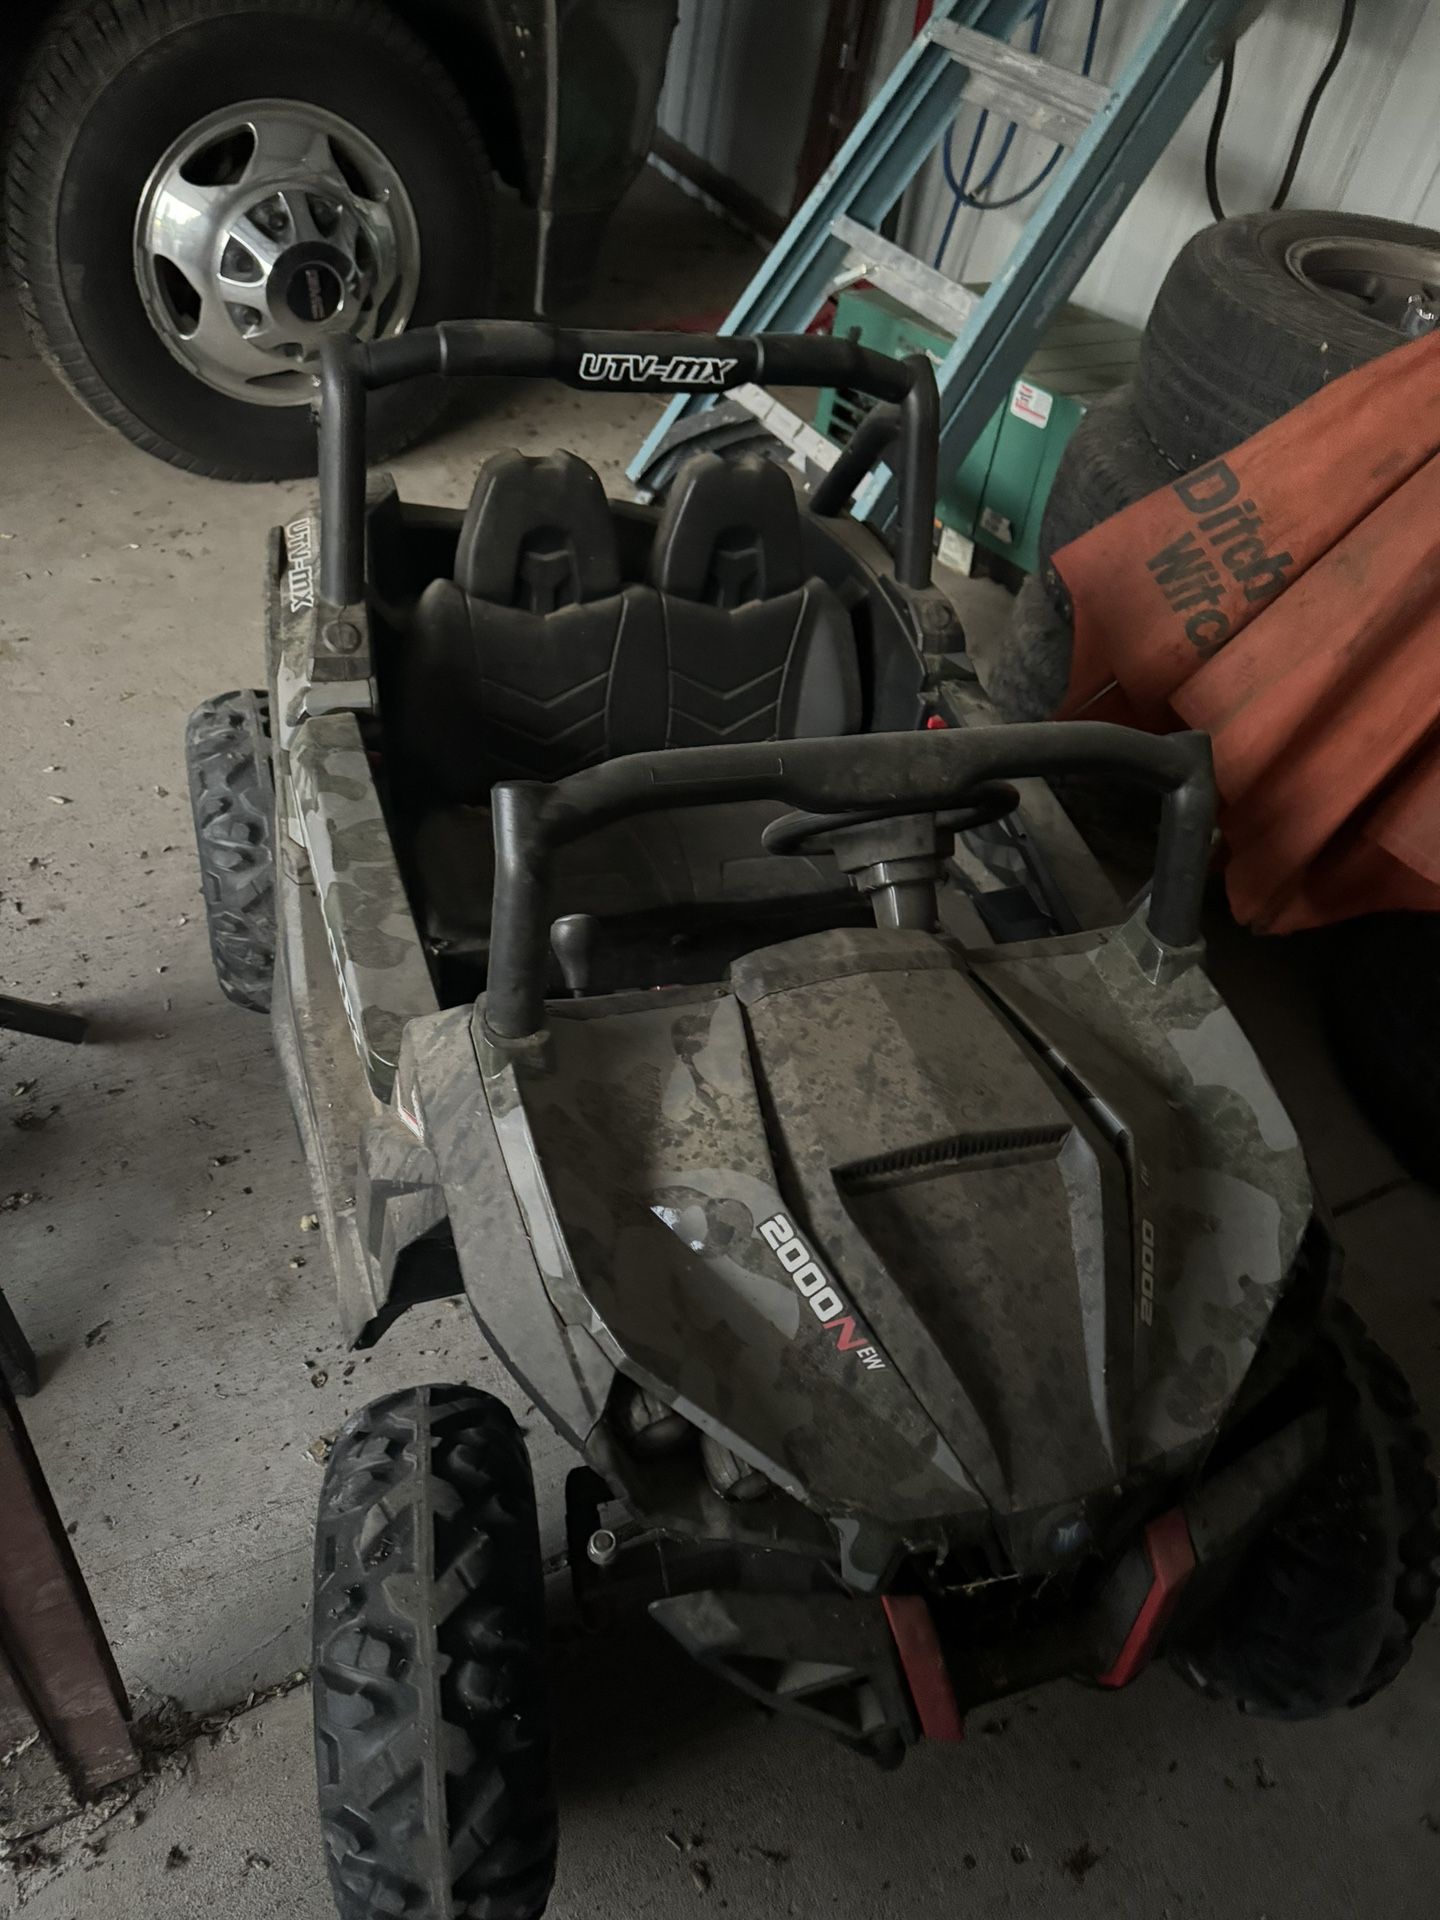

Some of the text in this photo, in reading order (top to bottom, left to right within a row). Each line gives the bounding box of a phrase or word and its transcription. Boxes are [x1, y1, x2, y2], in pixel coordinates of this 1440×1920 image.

[1173, 459, 1294, 602] Ditch
[1146, 531, 1230, 660] Witc
[1140, 1218, 1155, 1327] 2000
